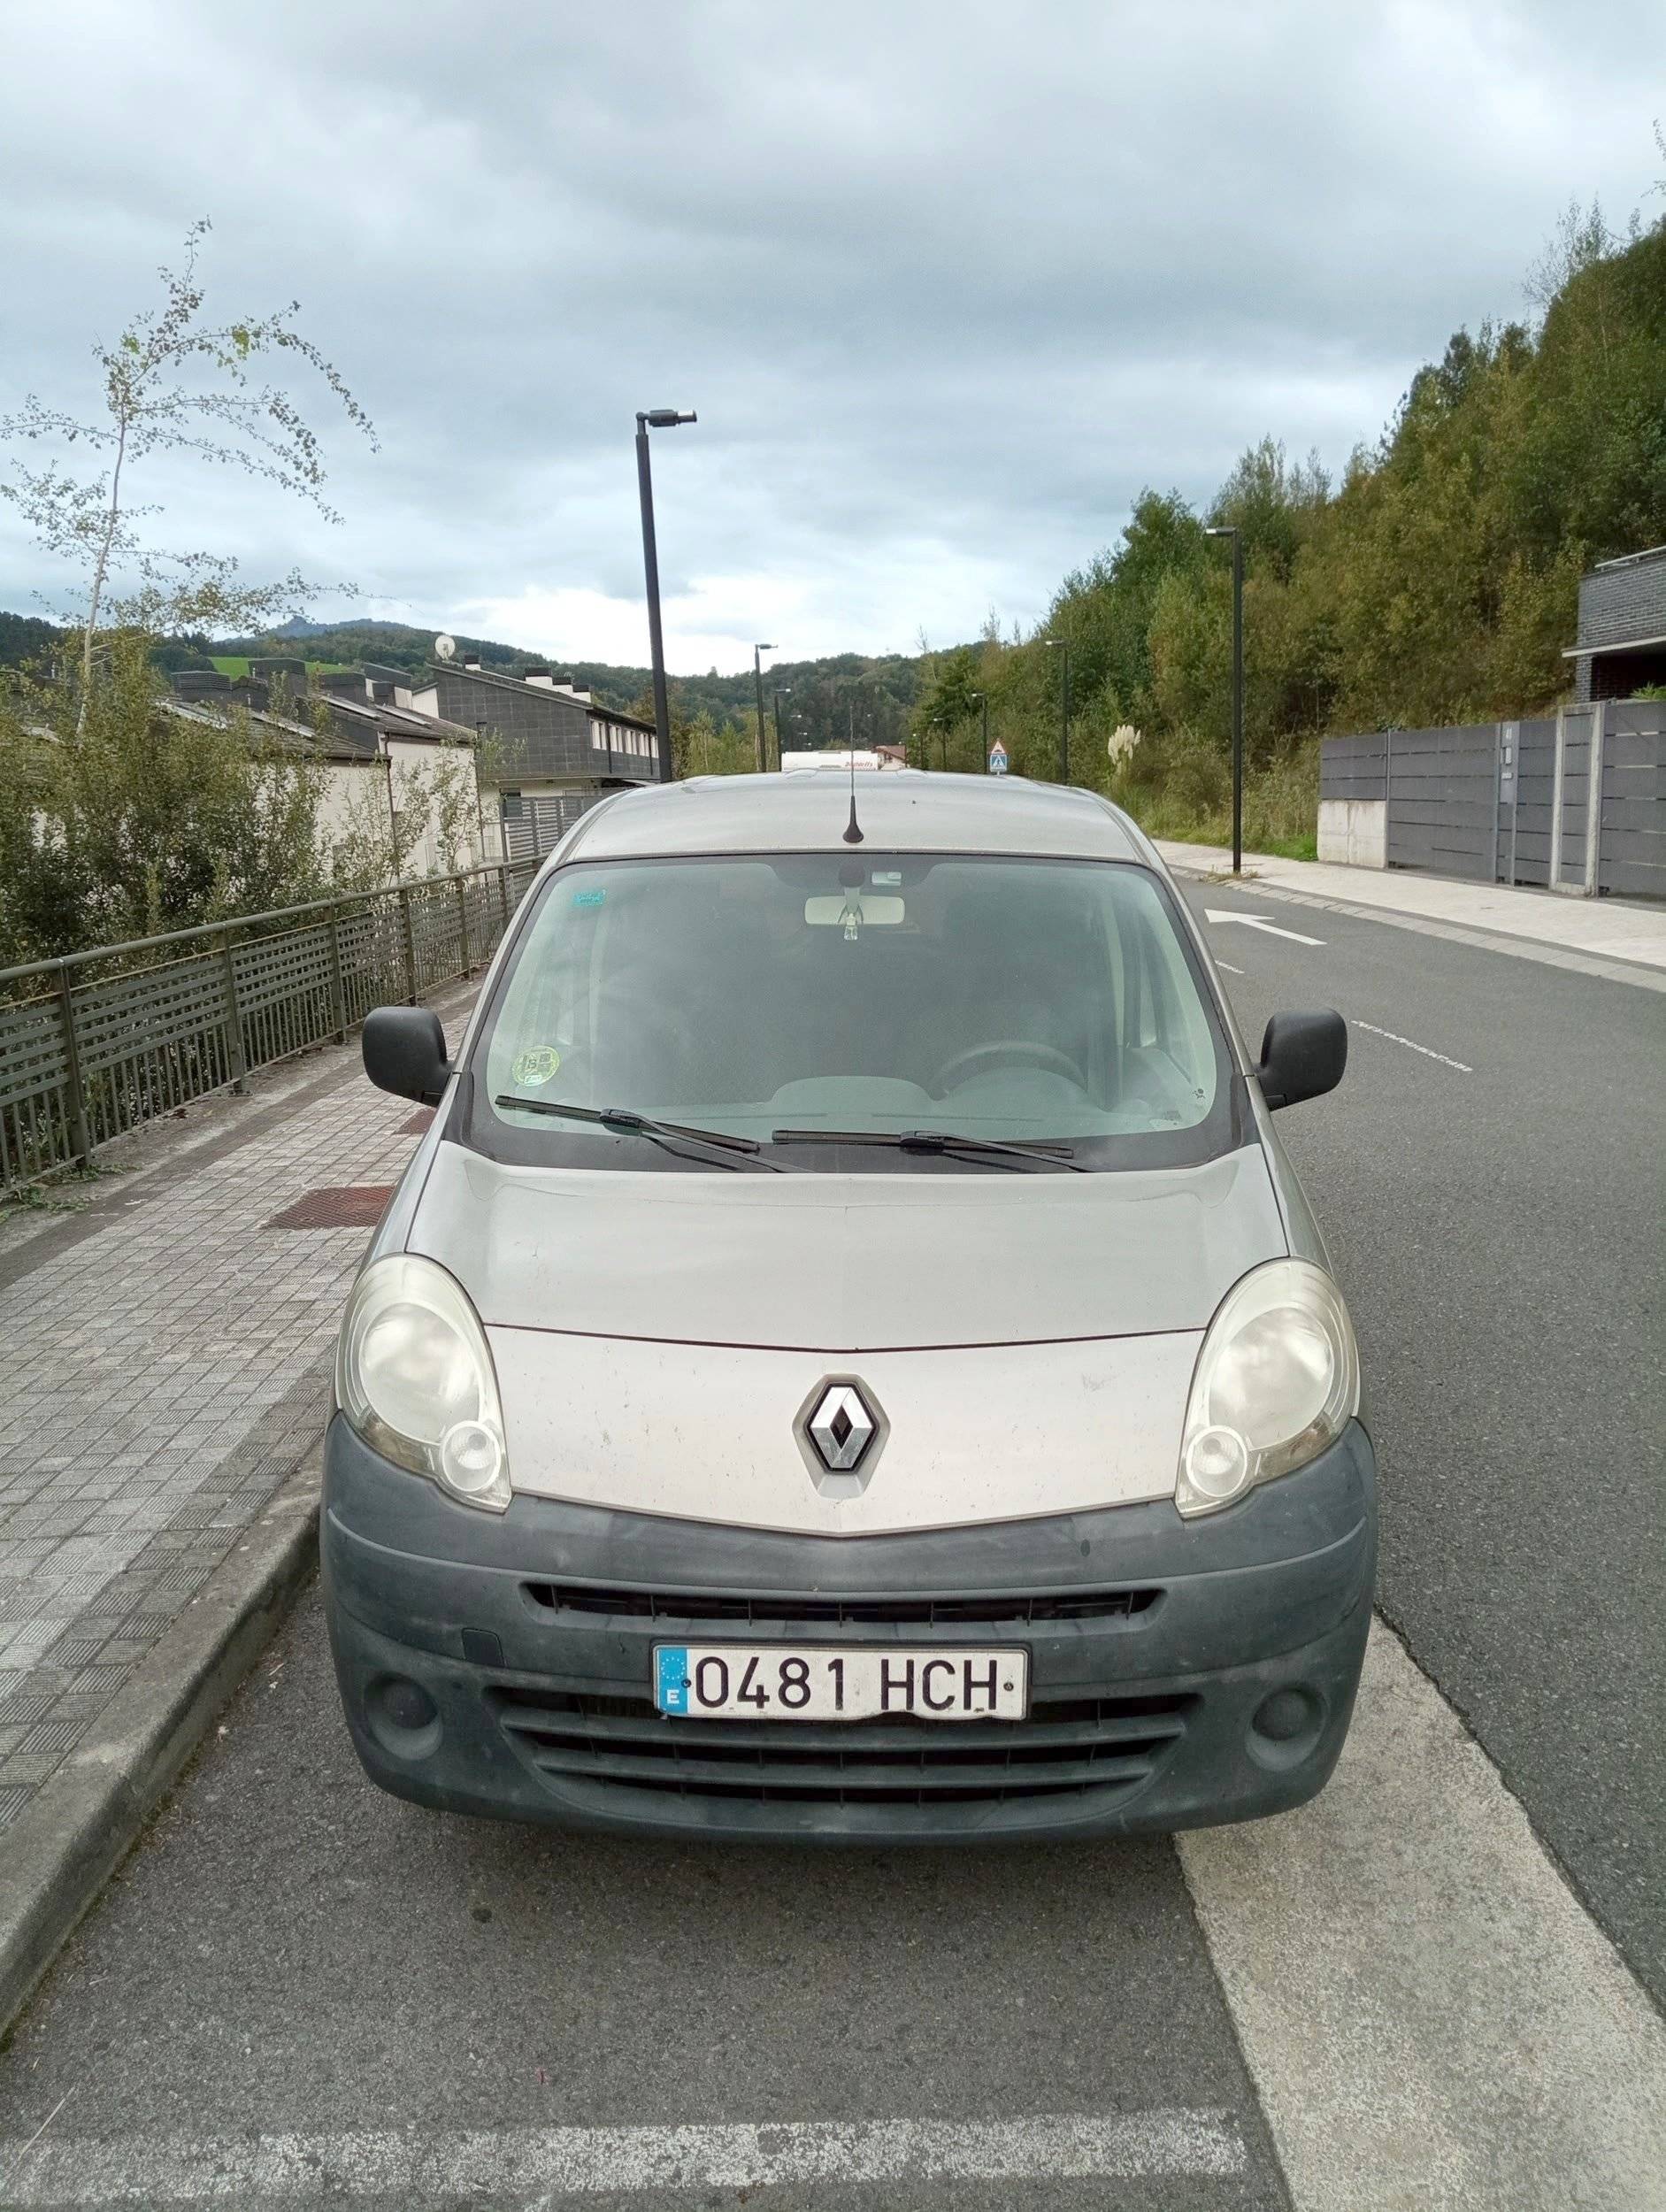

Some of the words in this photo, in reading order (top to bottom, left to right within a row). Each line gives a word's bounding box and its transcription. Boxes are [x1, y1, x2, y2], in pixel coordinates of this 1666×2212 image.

[666, 1689, 680, 1704] E
[695, 1655, 844, 1710] 0481
[880, 1658, 998, 1711] HCH
